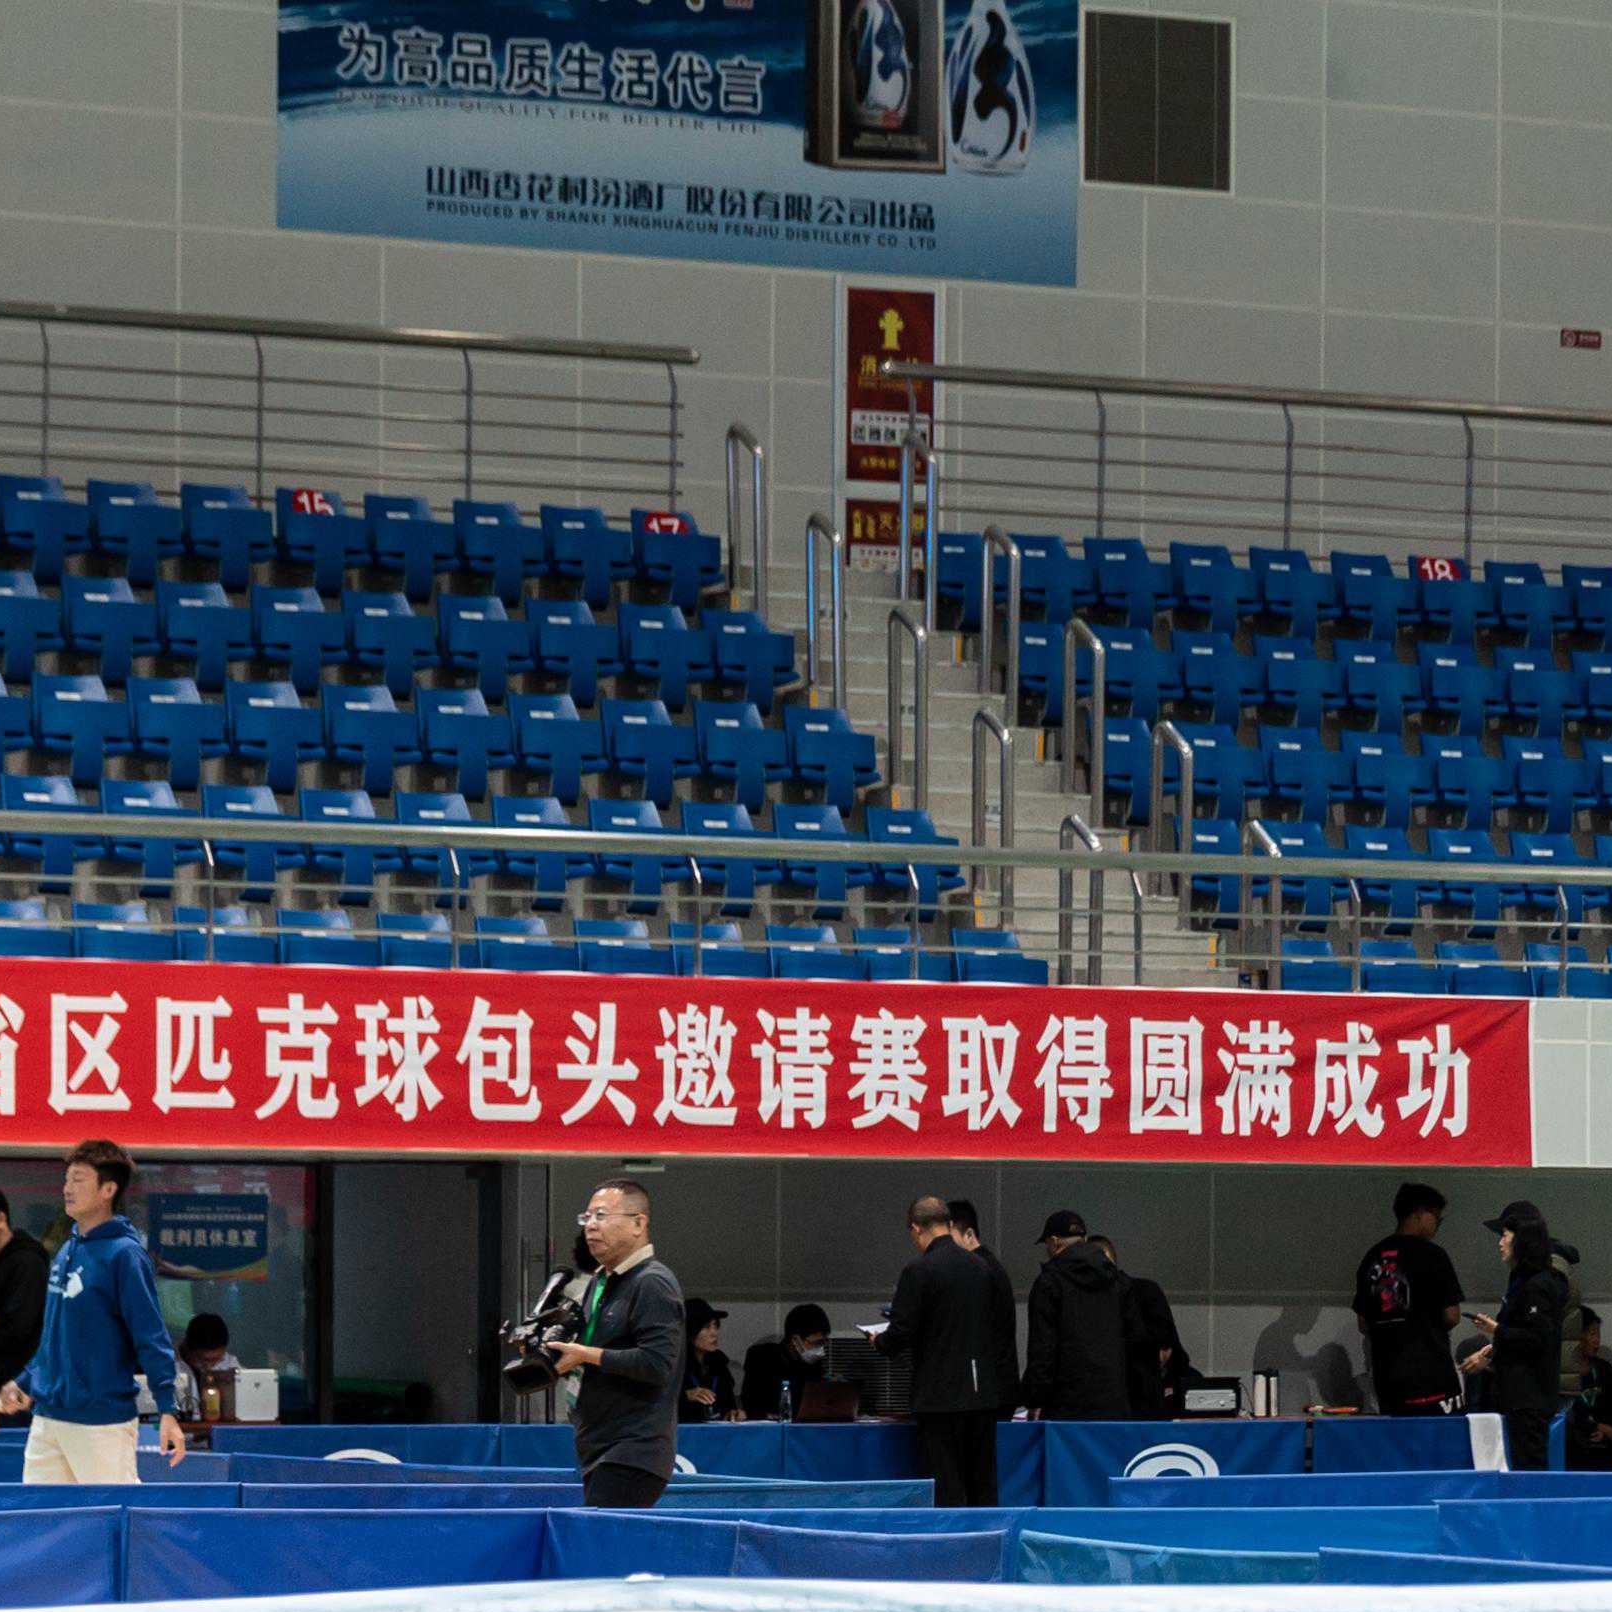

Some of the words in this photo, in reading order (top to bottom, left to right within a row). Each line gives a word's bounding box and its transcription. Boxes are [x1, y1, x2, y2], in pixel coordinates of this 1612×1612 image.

[336, 22, 767, 115] 为高品质生活代言
[426, 166, 936, 233] 山西杏花村汾酒厂股份有限公司出品
[426, 200, 513, 219] PRODUCED
[520, 206, 541, 220] BY
